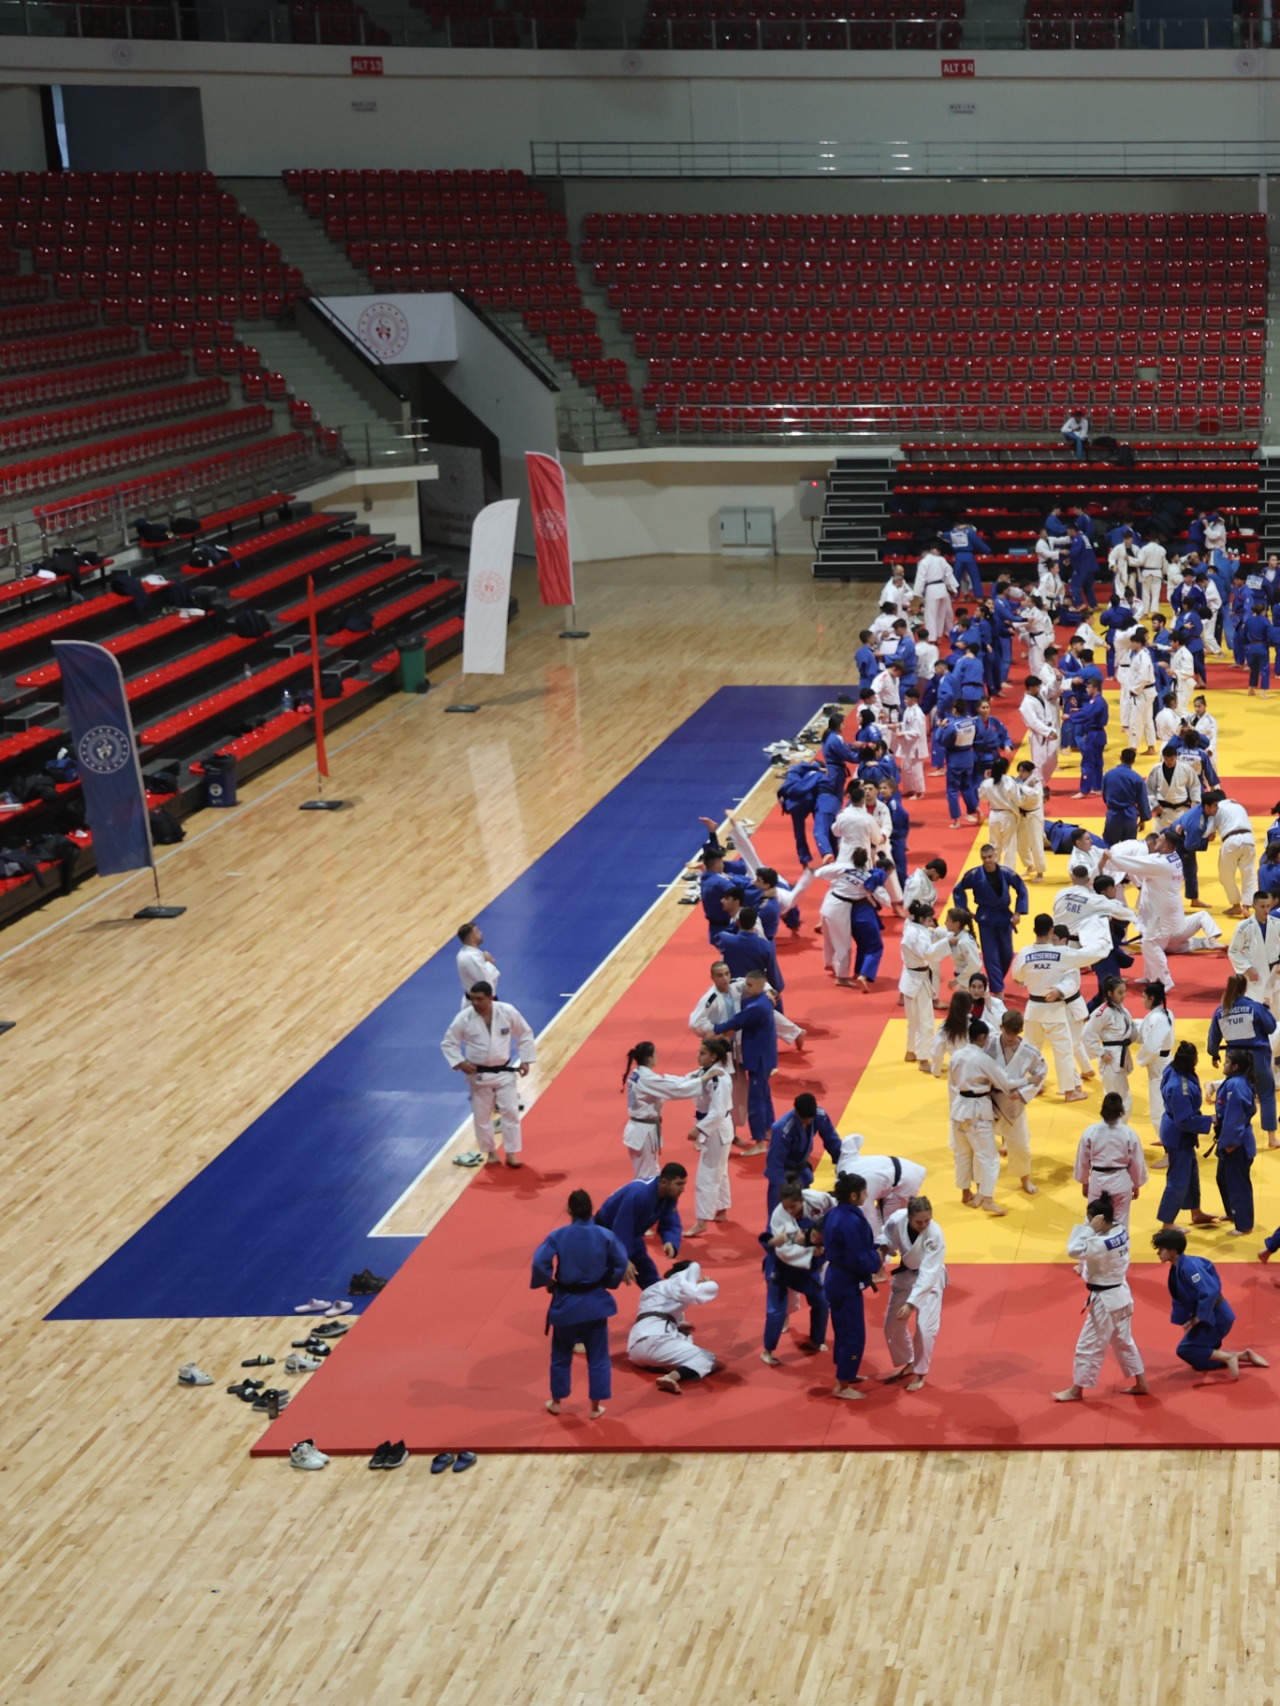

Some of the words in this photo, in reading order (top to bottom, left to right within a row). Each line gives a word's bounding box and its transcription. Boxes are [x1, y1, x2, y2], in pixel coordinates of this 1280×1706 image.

[353, 60, 368, 71] ALT
[943, 63, 959, 73] ALT
[961, 63, 974, 73] 14
[846, 876, 860, 886] KAZ
[1066, 902, 1082, 914] GRE
[1227, 1017, 1244, 1025] TUR
